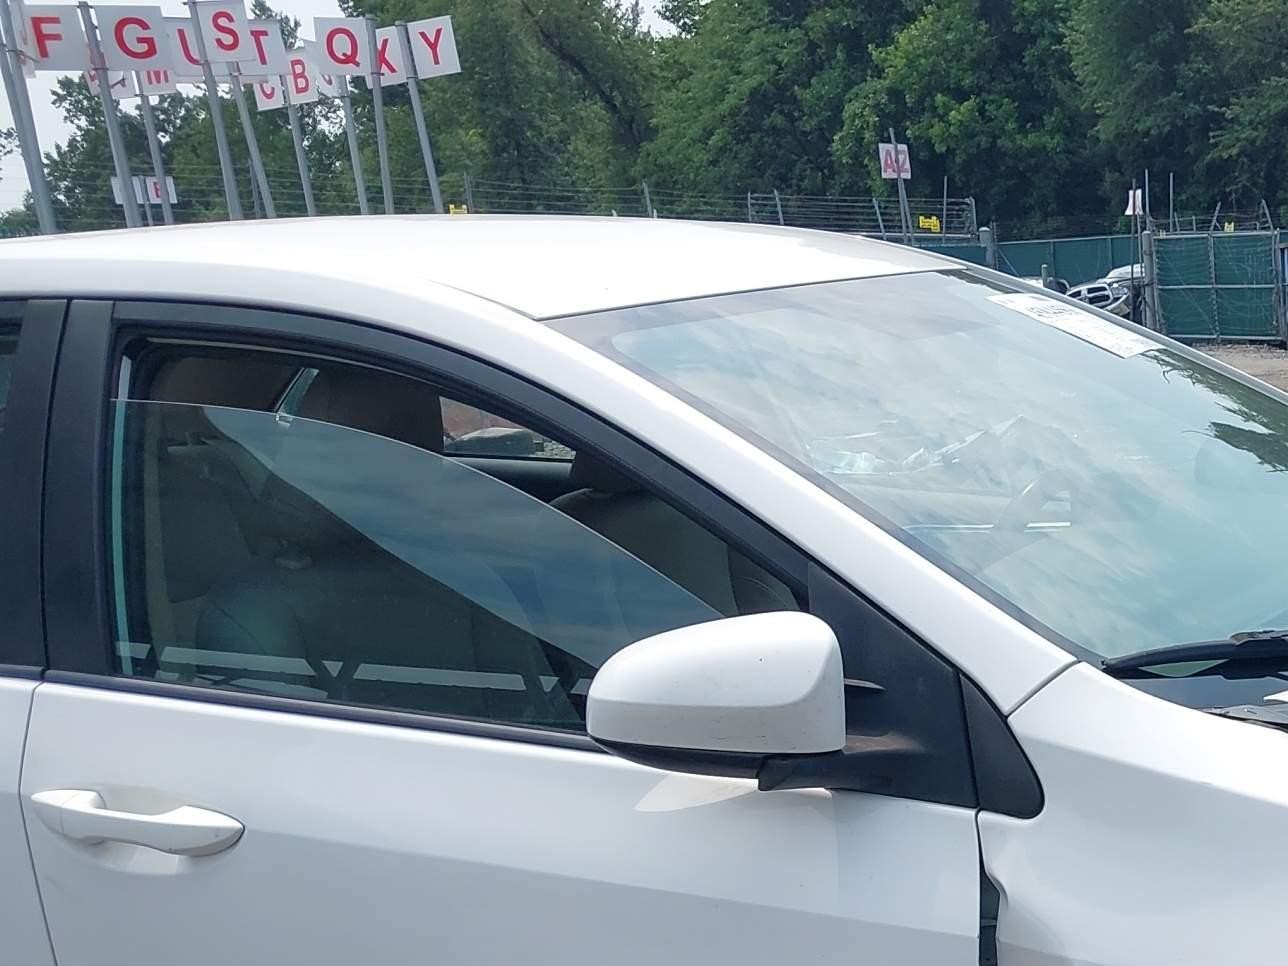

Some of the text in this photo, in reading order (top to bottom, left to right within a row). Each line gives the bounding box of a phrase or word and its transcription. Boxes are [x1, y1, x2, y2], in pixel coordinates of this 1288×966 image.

[30, 16, 63, 59] F
[113, 16, 158, 60] G
[211, 10, 241, 51] S
[325, 27, 361, 68] Q
[417, 27, 443, 65] Y
[289, 59, 310, 95] B
